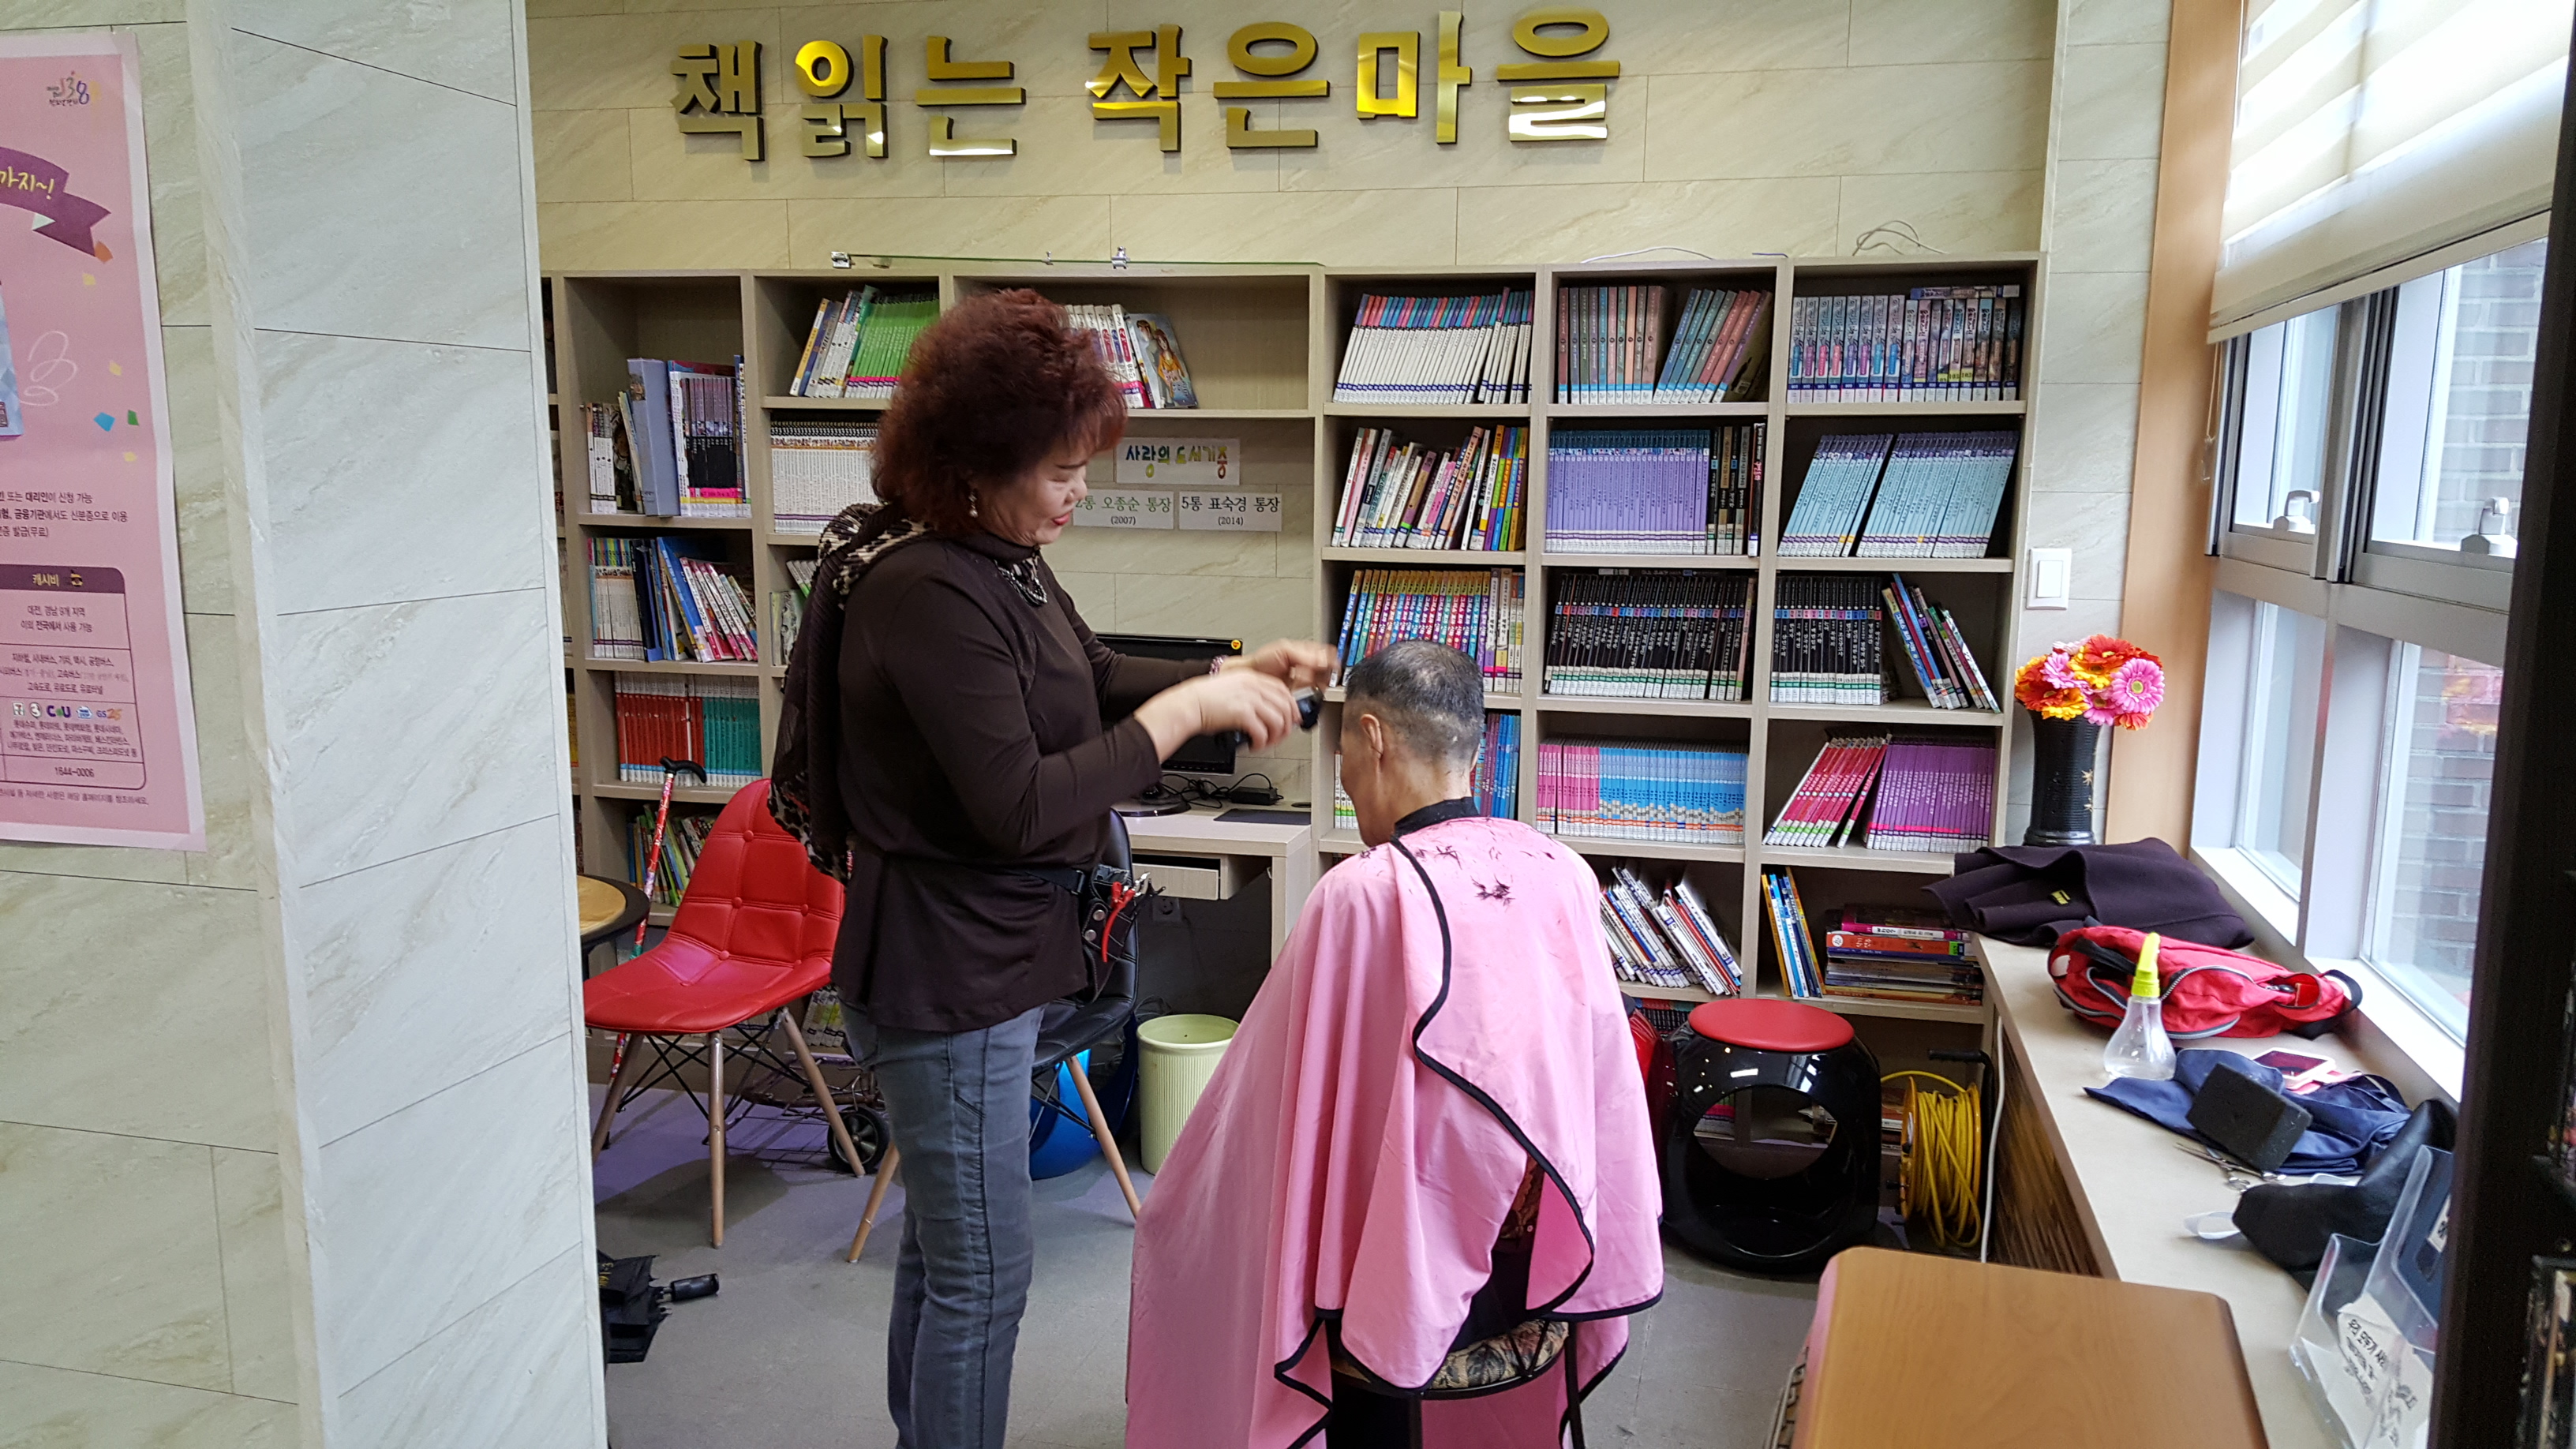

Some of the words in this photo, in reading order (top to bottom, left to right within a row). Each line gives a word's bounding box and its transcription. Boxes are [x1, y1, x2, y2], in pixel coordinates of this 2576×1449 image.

[1125, 445, 1170, 478] 사랑의
[1176, 445, 1228, 479] 도서기증
[7, 492, 24, 503] 또는
[25, 492, 56, 504] 대리인이
[58, 492, 74, 504] 신청
[77, 493, 93, 504] 가능
[1102, 496, 1140, 511] 오종순
[1145, 496, 1172, 513] 통장
[1181, 496, 1204, 511] 5통
[1208, 496, 1247, 512] 표숙경
[1253, 496, 1281, 513] 통장
[14, 509, 69, 521] 금융기관에서도
[71, 510, 110, 522] 신분증으로
[111, 511, 129, 522] 이용
[1110, 515, 1136, 526] (2007)
[1218, 515, 1245, 526] (2014)
[13, 526, 49, 538] 발급(무료)
[32, 573, 60, 586] 캐시비
[36, 620, 62, 631] 전국에서
